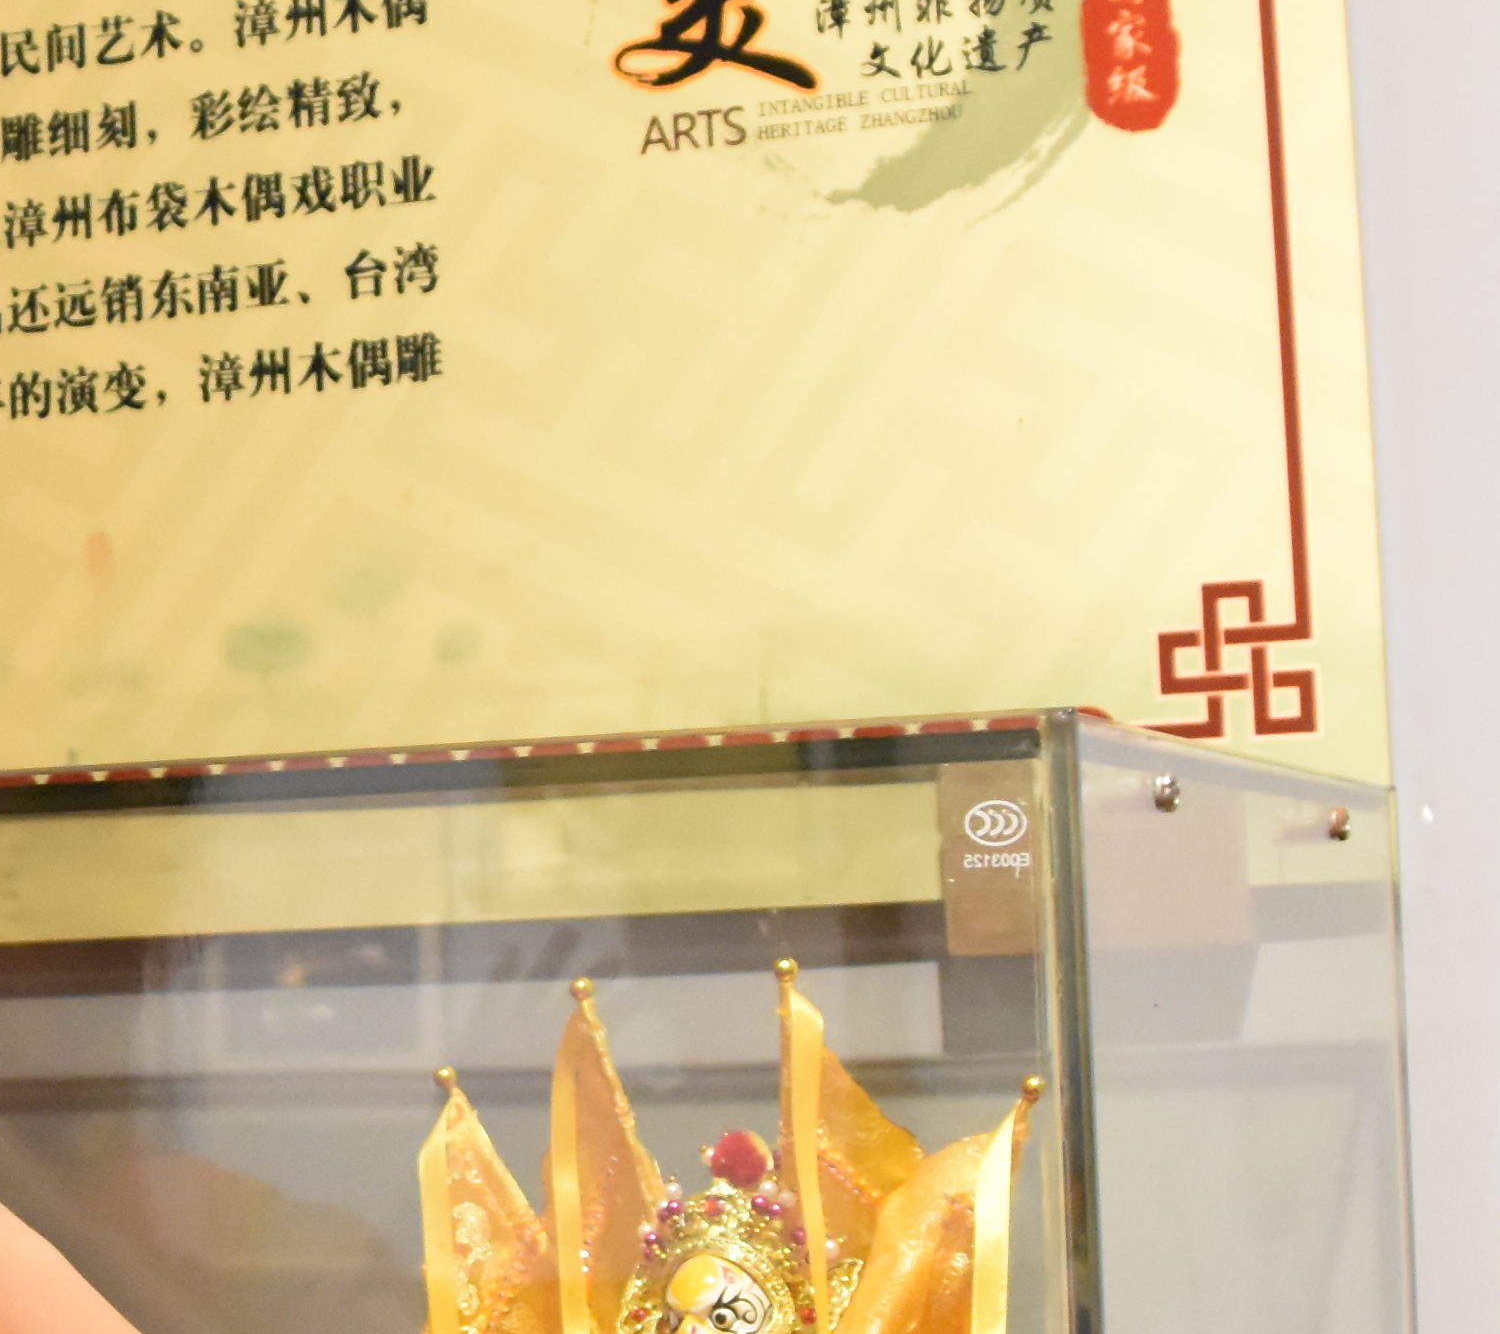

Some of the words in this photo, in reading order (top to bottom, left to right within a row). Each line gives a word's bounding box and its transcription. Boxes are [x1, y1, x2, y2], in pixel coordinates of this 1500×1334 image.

[861, 24, 1055, 81] 文化遗产
[759, 90, 870, 117] INTANGIBLE
[881, 79, 973, 104] CULTURAL
[639, 103, 749, 156] ARTS
[757, 116, 848, 141] HERITAGE
[860, 104, 963, 130] ZHANGZHOU
